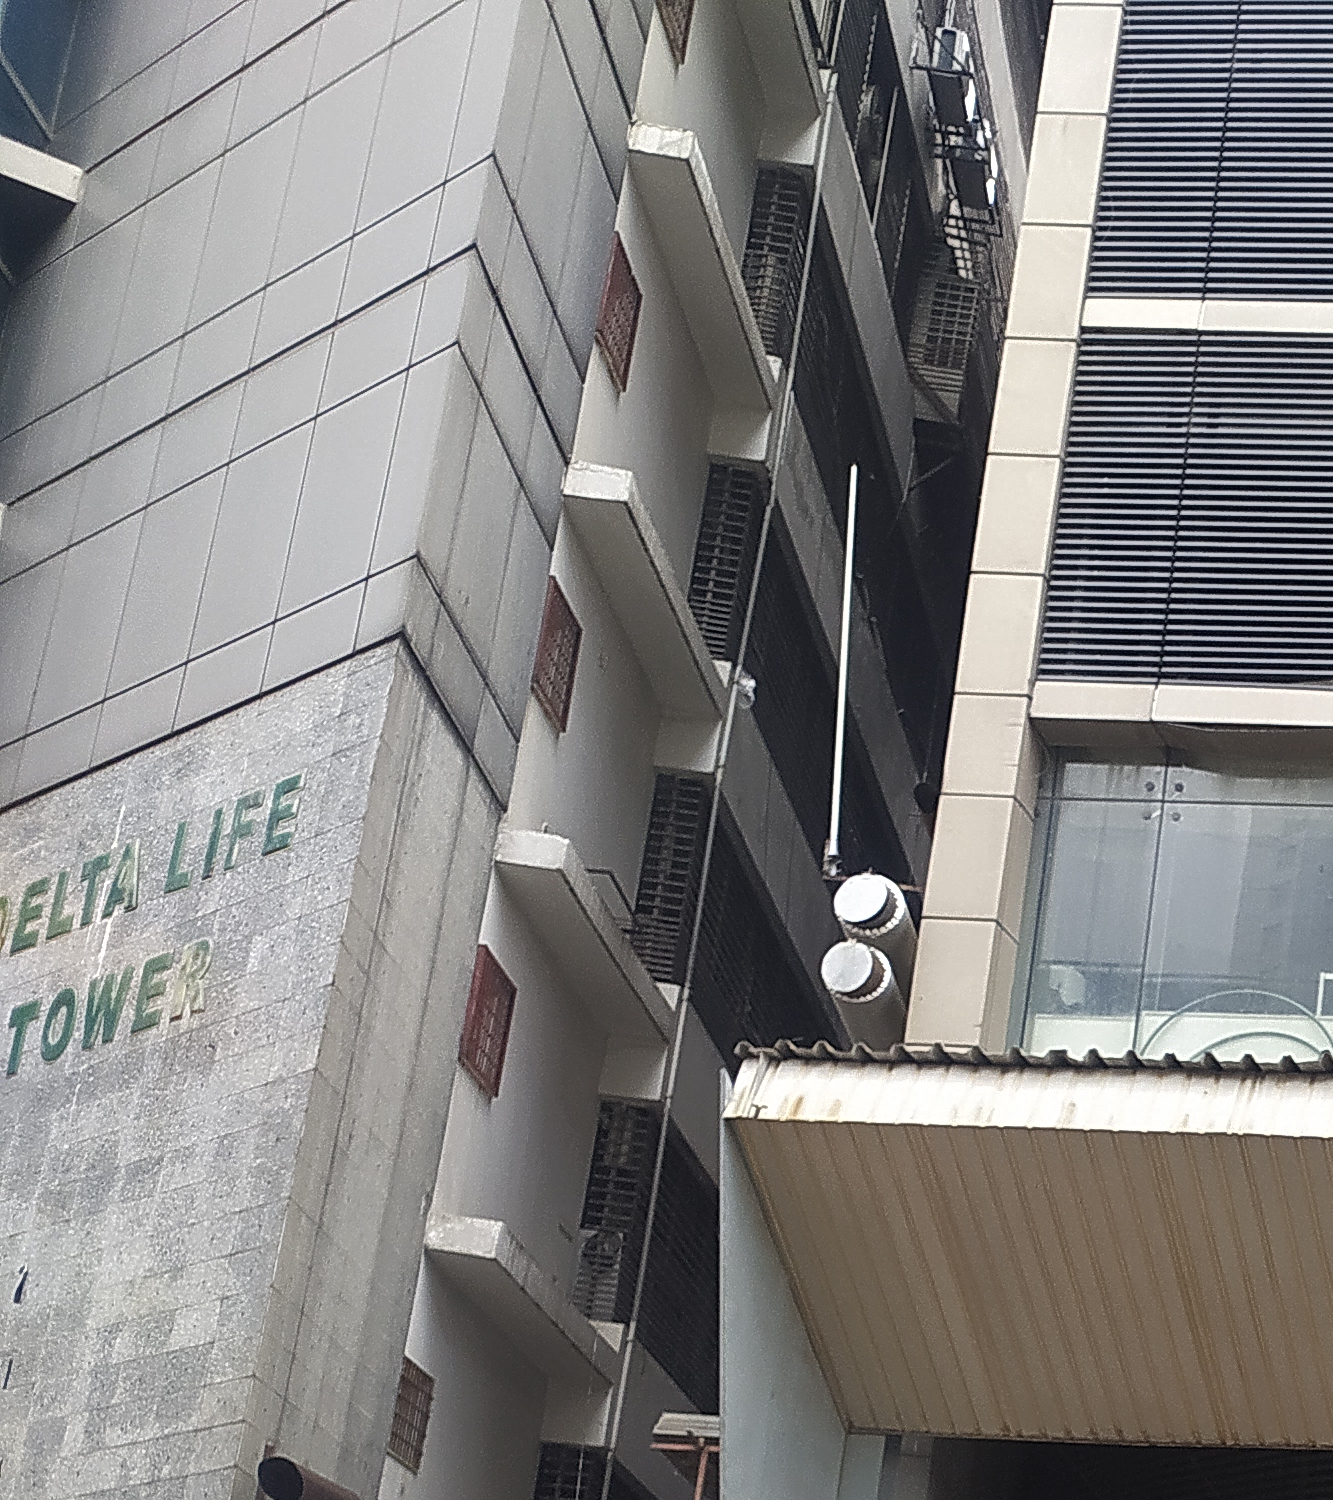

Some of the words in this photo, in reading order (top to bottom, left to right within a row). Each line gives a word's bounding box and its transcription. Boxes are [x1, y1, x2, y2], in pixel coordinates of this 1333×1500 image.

[0, 839, 140, 957] ELTA
[164, 772, 303, 895] LIFE
[6, 938, 212, 1078] TOWER
